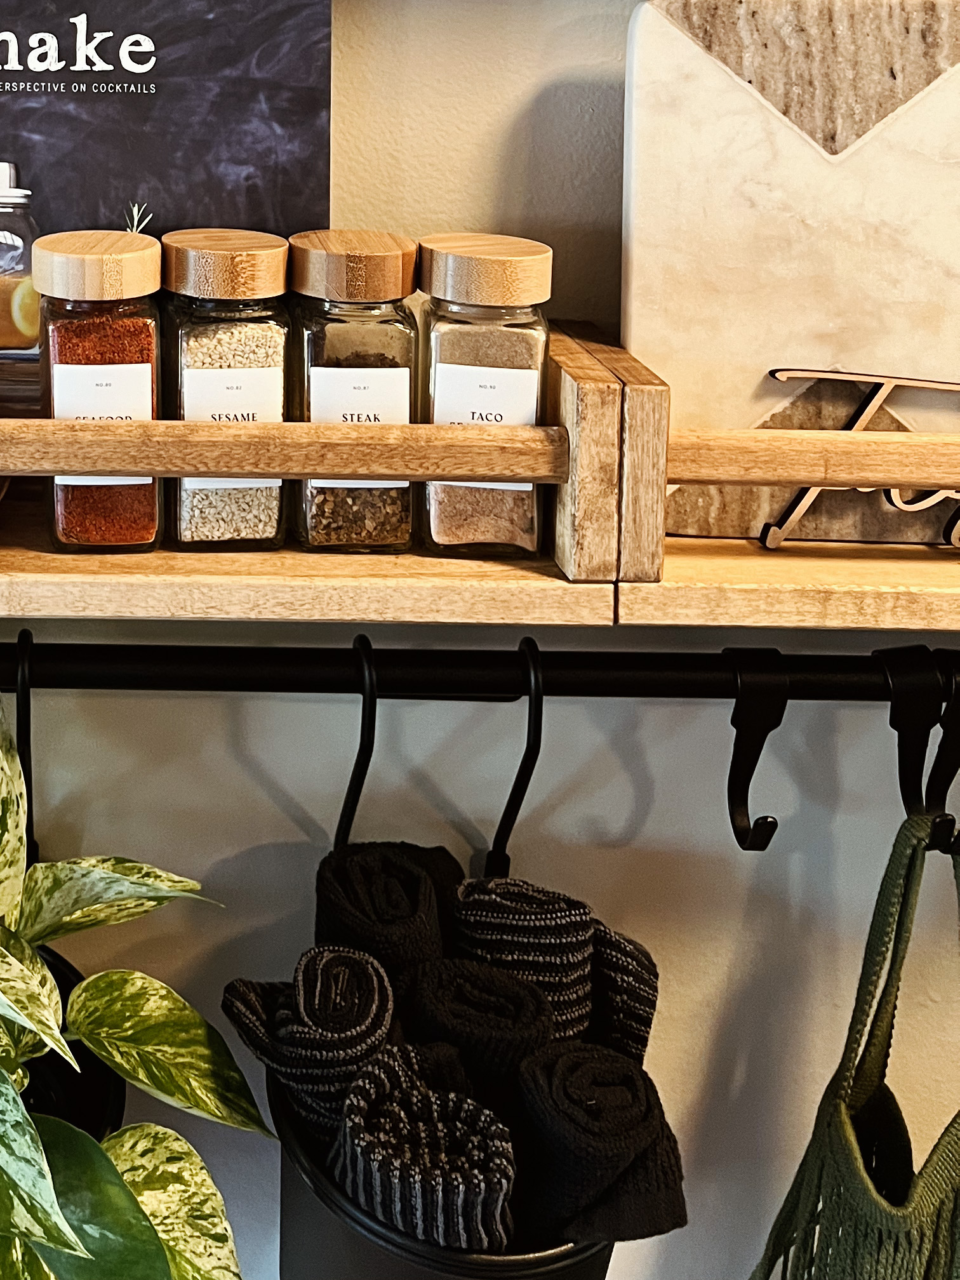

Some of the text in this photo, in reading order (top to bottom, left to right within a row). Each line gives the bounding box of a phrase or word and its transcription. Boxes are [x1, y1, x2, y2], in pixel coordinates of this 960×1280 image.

[71, 83, 86, 92] ON
[92, 83, 156, 93] COCKTAILS
[211, 413, 258, 422] SESAME
[342, 413, 381, 423] STEAK
[470, 411, 503, 422] TACO
